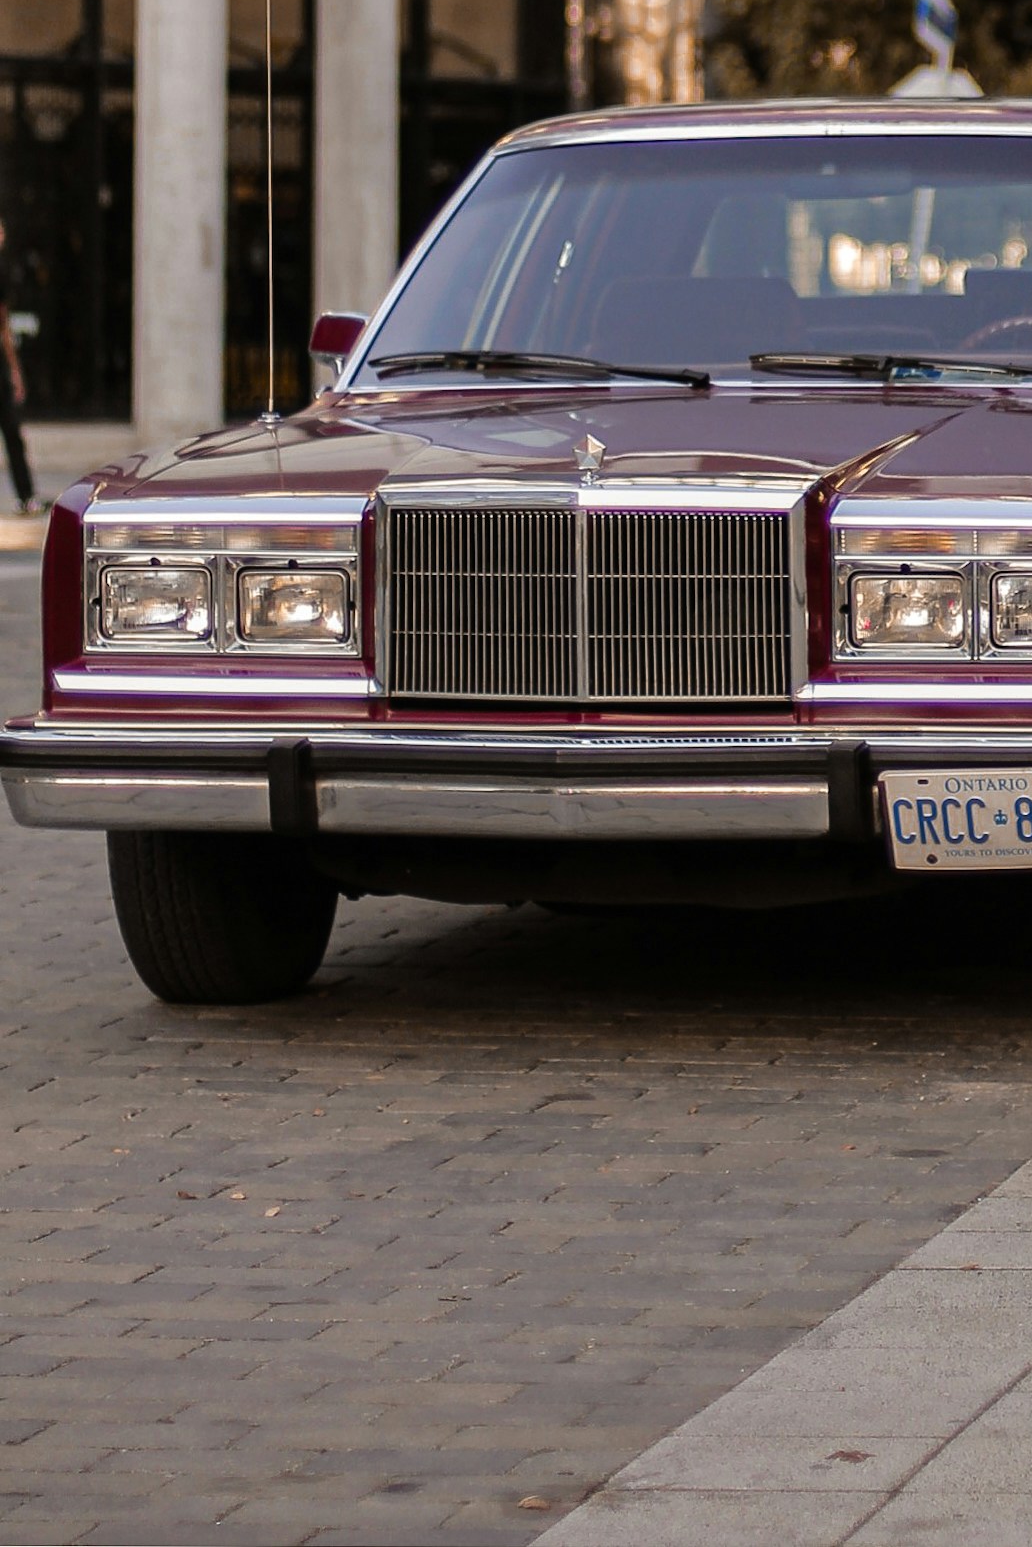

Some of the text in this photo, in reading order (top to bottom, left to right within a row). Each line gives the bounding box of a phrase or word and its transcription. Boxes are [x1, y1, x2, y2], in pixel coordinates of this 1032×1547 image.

[944, 777, 1028, 794] ONTARIO
[893, 797, 990, 845] CRCC
[944, 849, 976, 857] YOURS
[980, 848, 993, 857] TO
